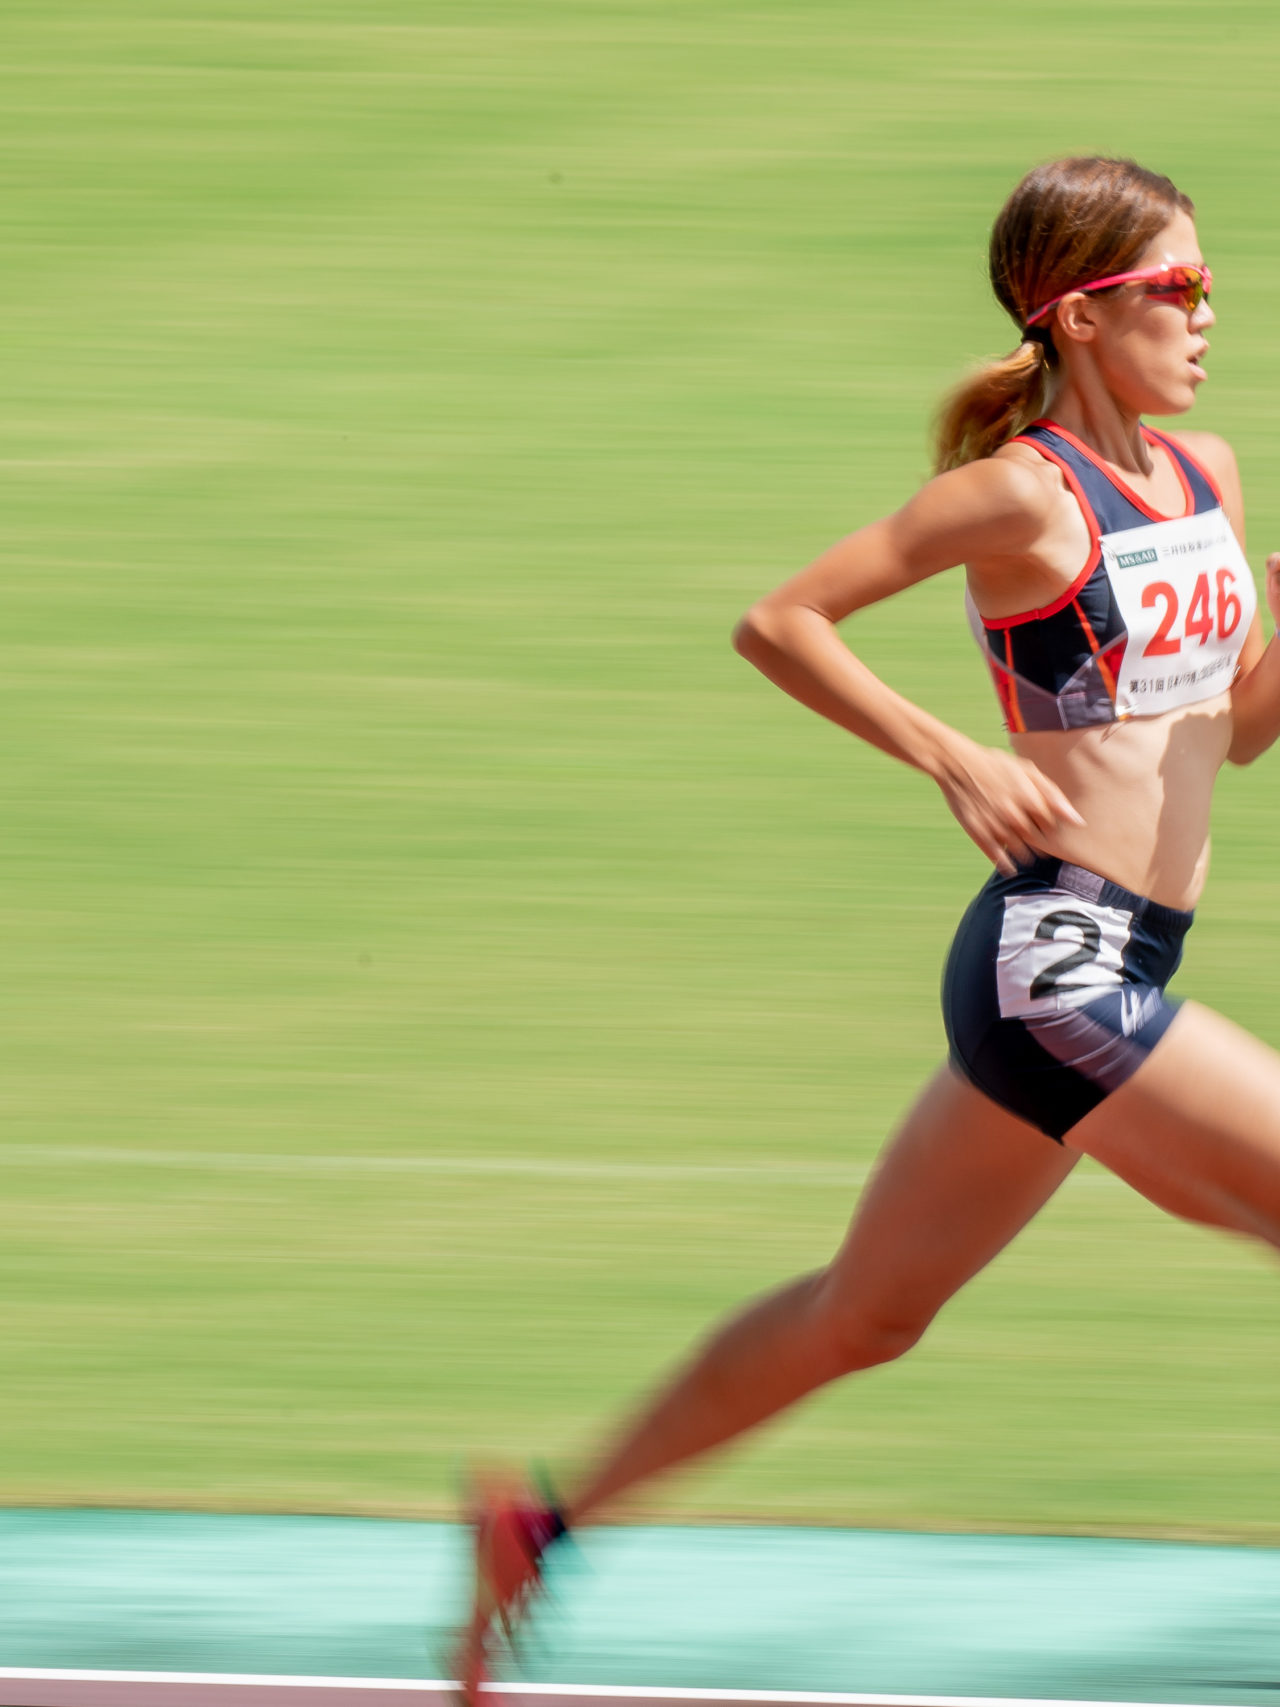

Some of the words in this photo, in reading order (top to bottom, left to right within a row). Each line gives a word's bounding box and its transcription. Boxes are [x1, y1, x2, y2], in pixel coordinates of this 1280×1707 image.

[1119, 550, 1157, 567] MS&AD
[1141, 567, 1242, 658] 246
[1029, 909, 1103, 1001] 2
